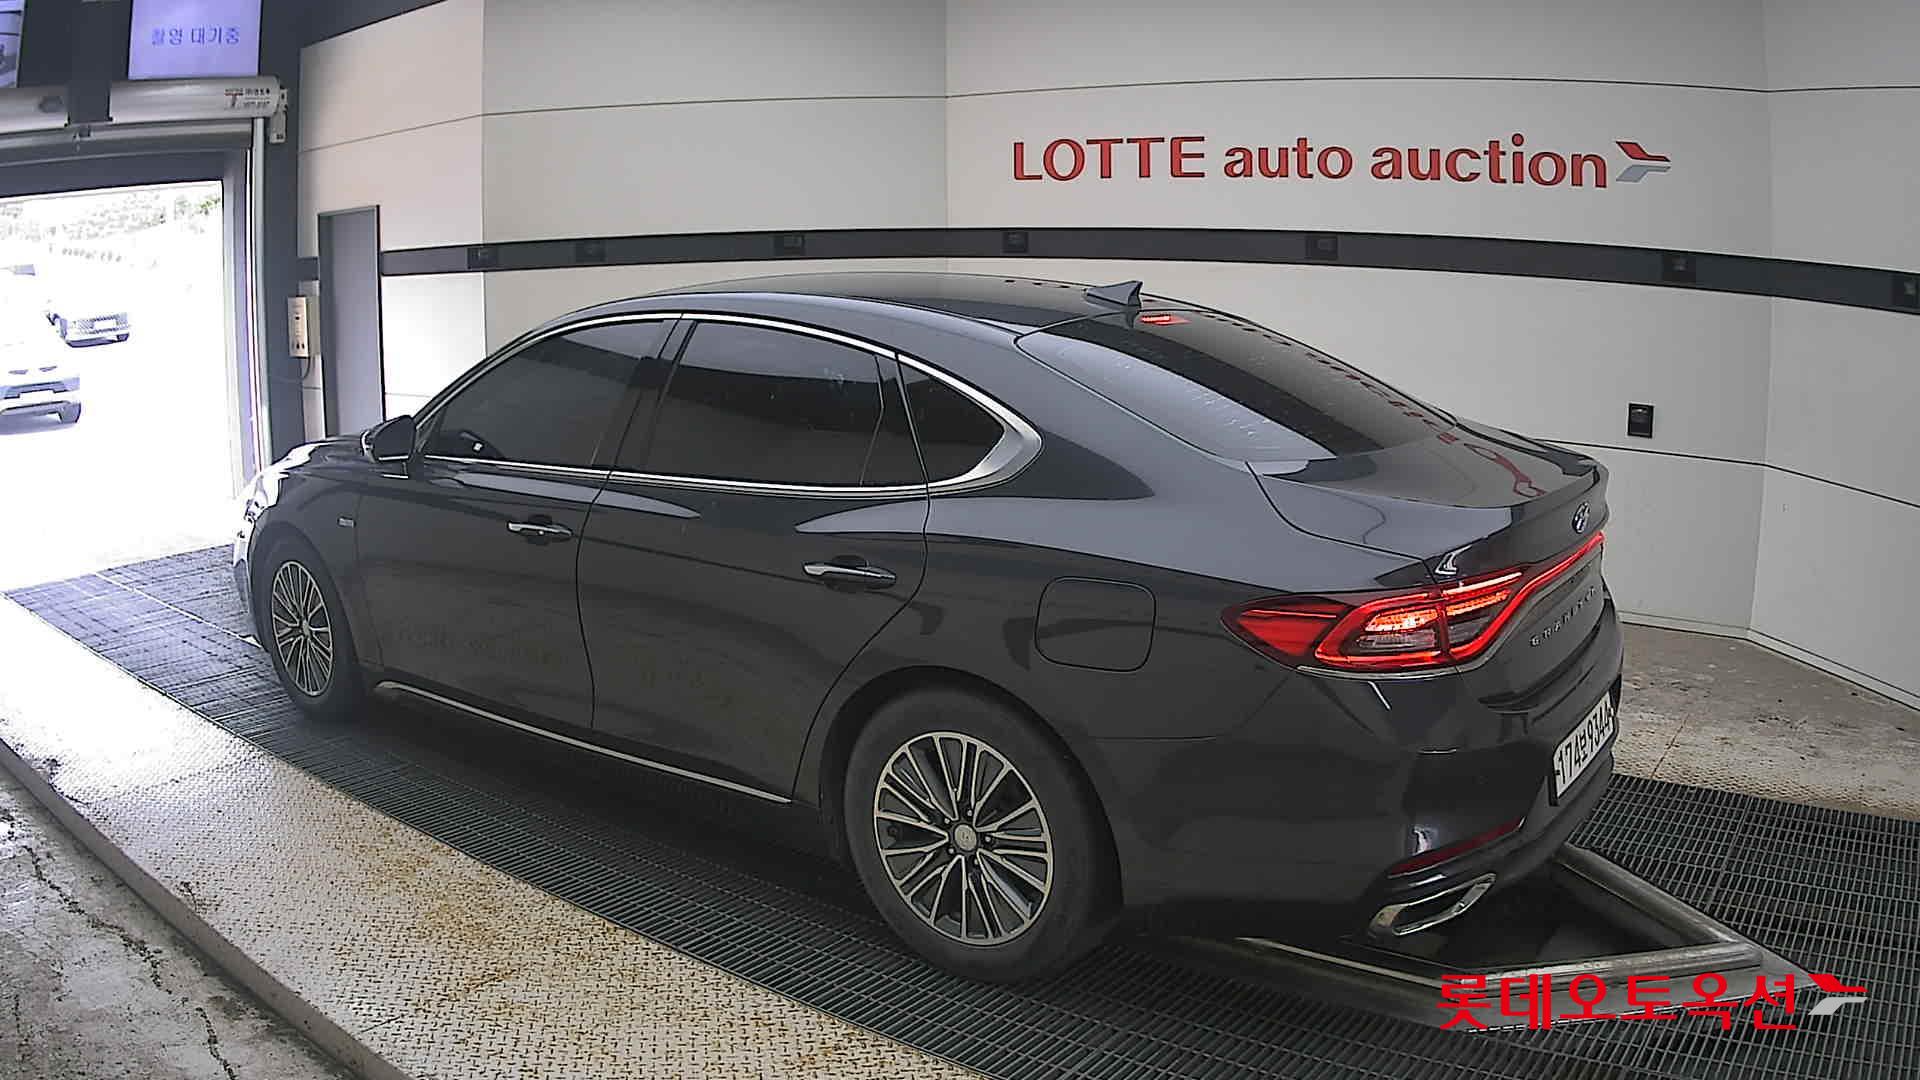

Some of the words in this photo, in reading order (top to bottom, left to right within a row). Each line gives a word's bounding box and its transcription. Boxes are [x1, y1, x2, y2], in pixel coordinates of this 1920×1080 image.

[191, 27, 239, 45] 대기중
[1012, 136, 1206, 181] LOTTE
[1223, 137, 1354, 180] auto
[1369, 133, 1608, 189] auction
